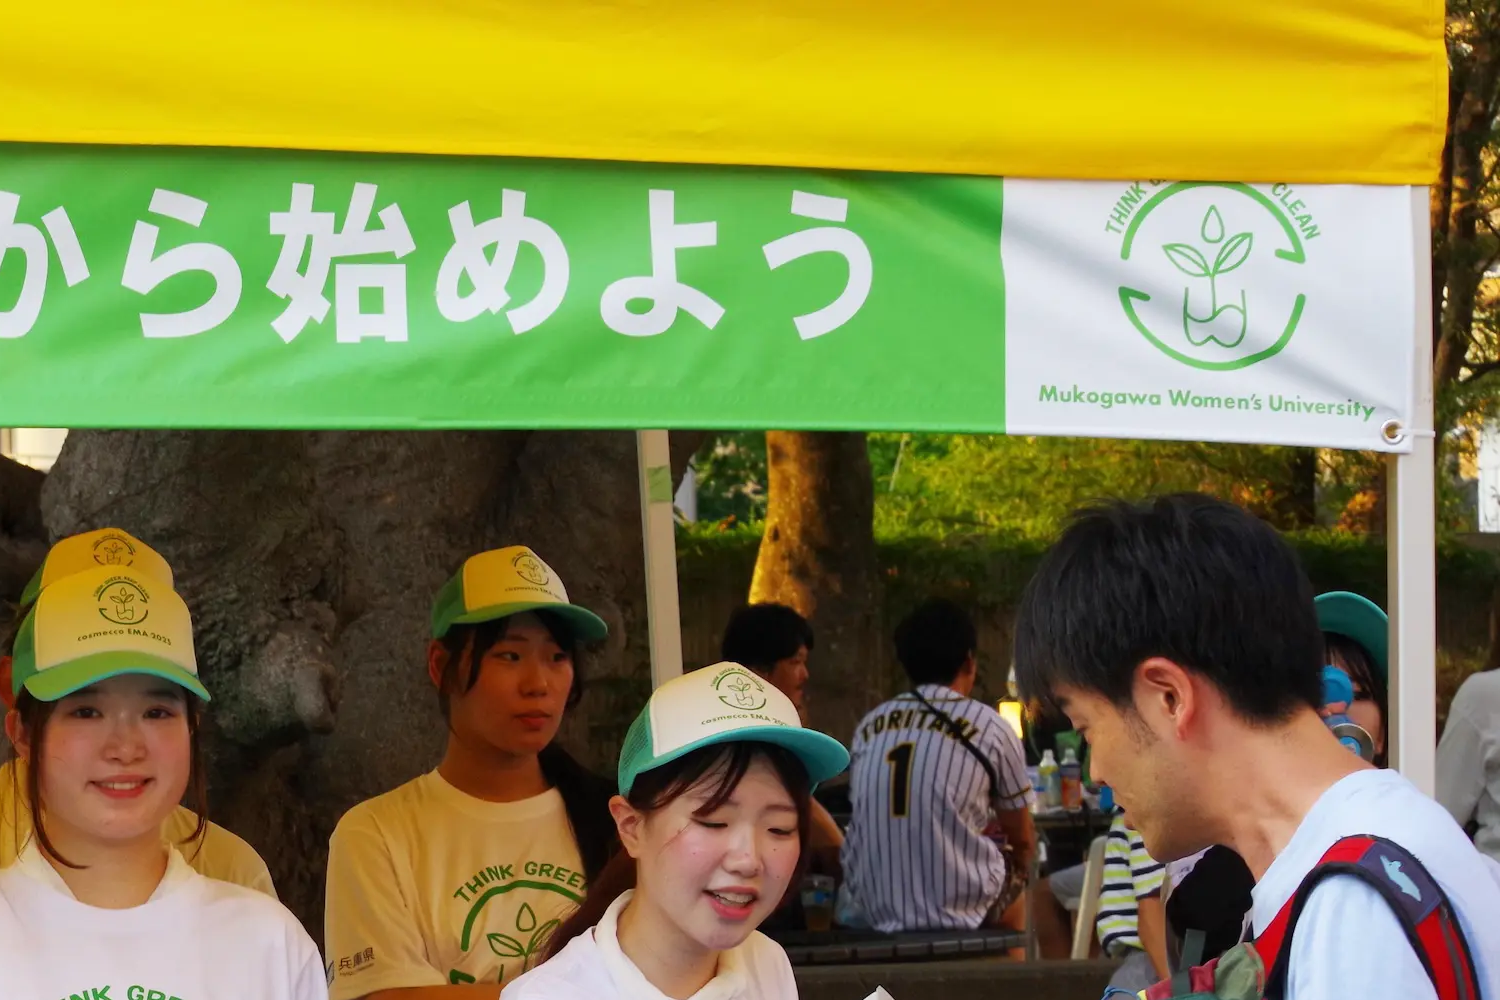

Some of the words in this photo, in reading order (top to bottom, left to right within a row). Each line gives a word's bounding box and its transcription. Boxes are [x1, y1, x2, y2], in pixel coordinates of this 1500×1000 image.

[1271, 182, 1321, 240] CLEAN
[1038, 384, 1161, 408] Mukogawa
[1168, 388, 1262, 411] Women's
[1269, 394, 1376, 422] University
[127, 628, 148, 637] EMA
[886, 741, 915, 818] 1
[453, 864, 514, 902] THINK
